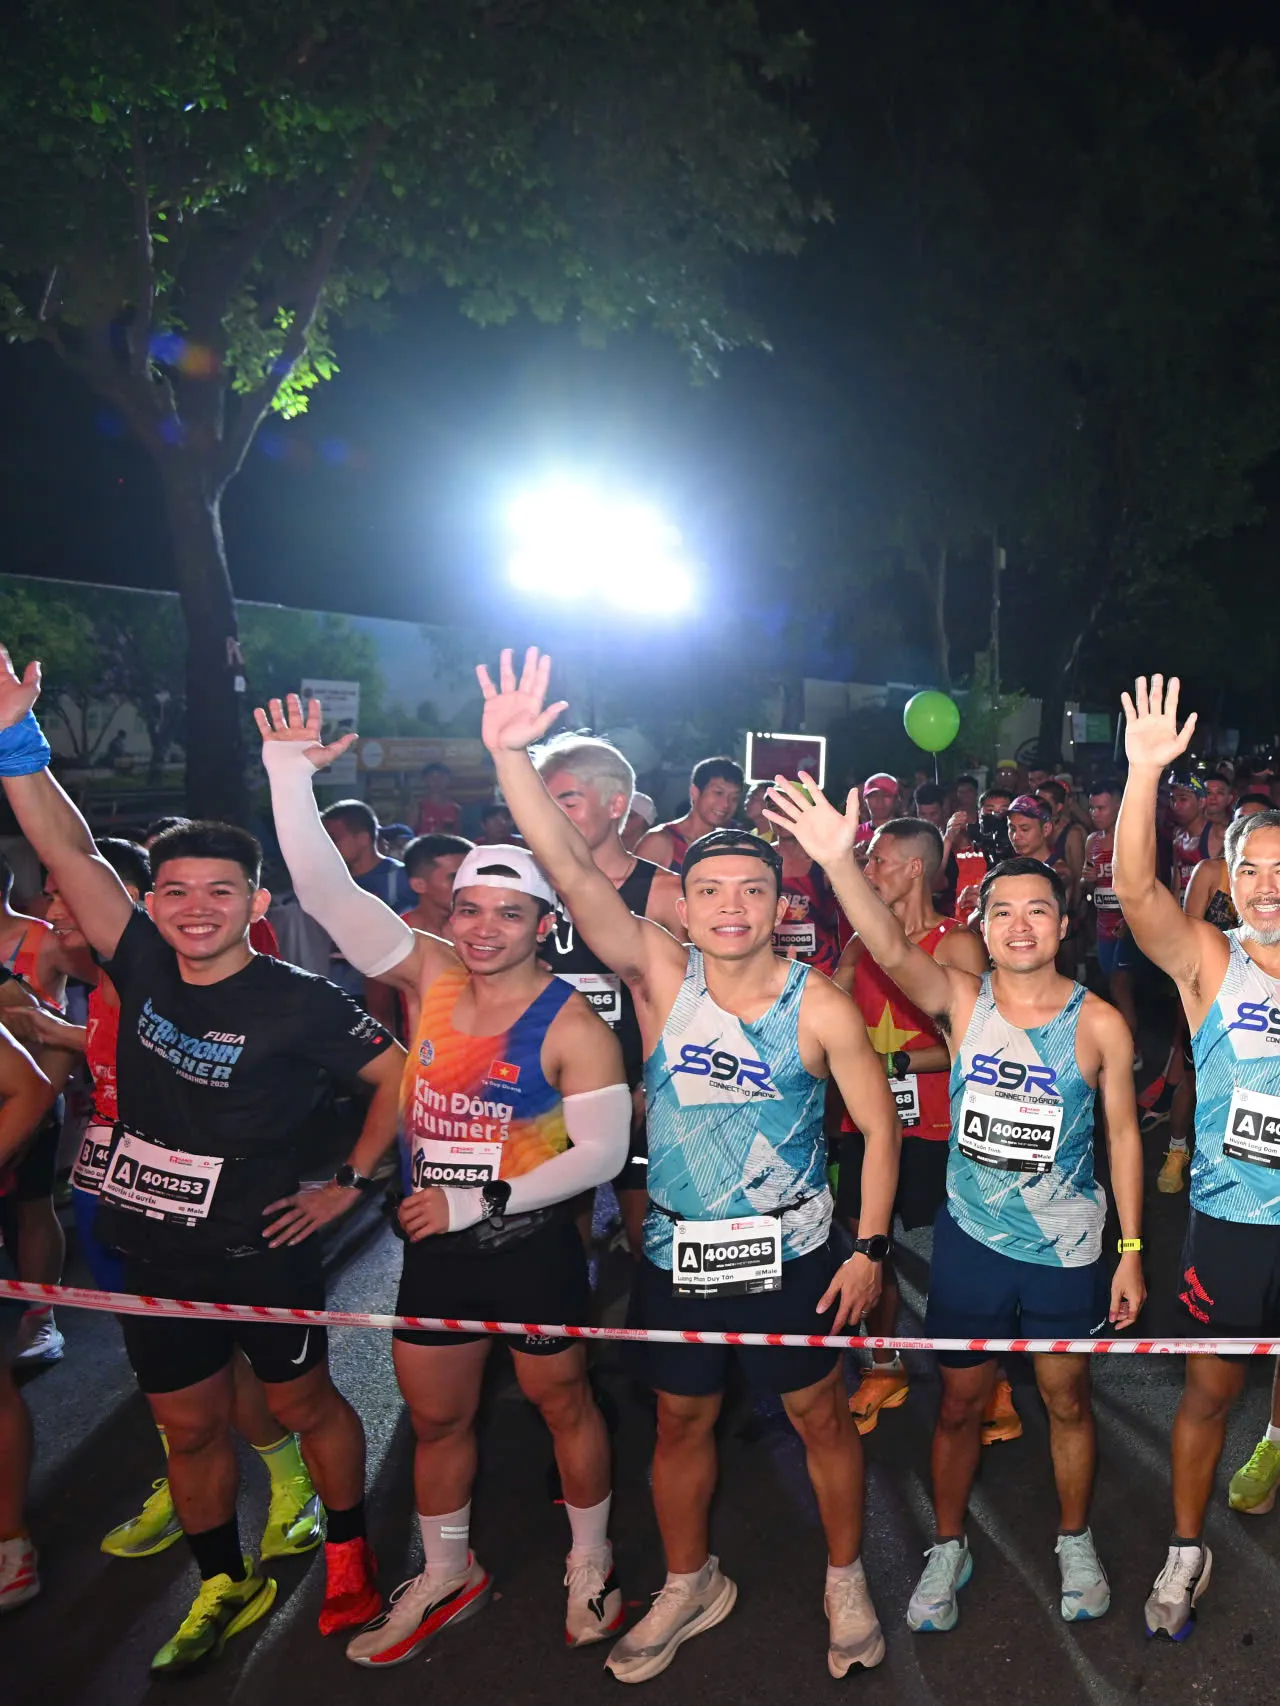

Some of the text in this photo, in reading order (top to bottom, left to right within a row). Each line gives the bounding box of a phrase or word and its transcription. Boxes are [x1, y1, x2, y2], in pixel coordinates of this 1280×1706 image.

[203, 1030, 246, 1045] FUGA
[671, 1044, 776, 1092] S9R
[965, 1053, 1061, 1097] S9R
[415, 1074, 513, 1123] Kim Động
[709, 1080, 740, 1093] CONNECT
[994, 1090, 1026, 1102] CONNECT
[1028, 1095, 1038, 1103] TO
[413, 1099, 510, 1141] Runners
[966, 1115, 1051, 1142] A 400204
[1236, 1114, 1256, 1137] A
[115, 1162, 131, 1185] A
[141, 1170, 204, 1195] 401253
[423, 1166, 490, 1182] 400454
[187, 1206, 205, 1215] Male
[681, 1241, 773, 1269] A 400265
